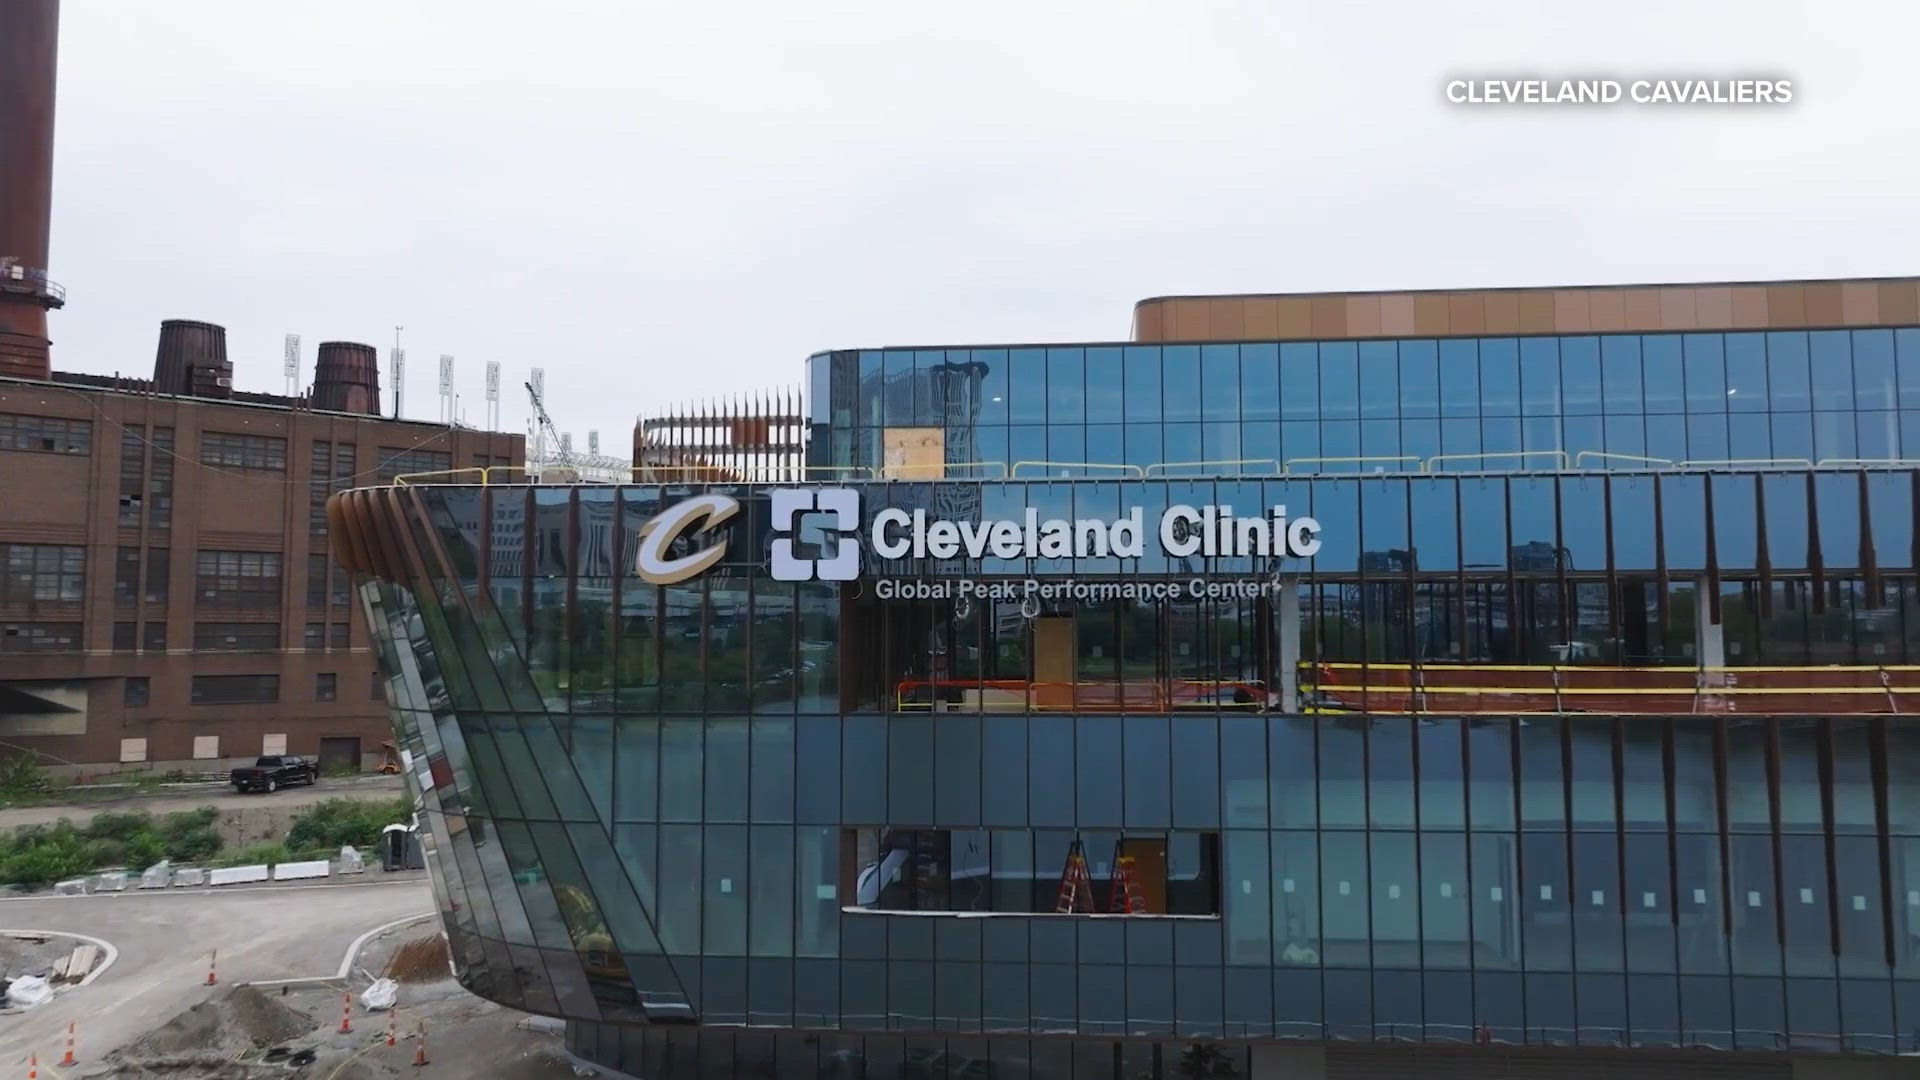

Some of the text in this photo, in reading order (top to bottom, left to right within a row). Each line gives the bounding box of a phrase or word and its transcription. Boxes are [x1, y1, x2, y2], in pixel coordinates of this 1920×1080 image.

[636, 494, 740, 585] C
[871, 504, 1322, 559] Cleveland Clinic
[875, 578, 1270, 599] Global Peak Performance Center
